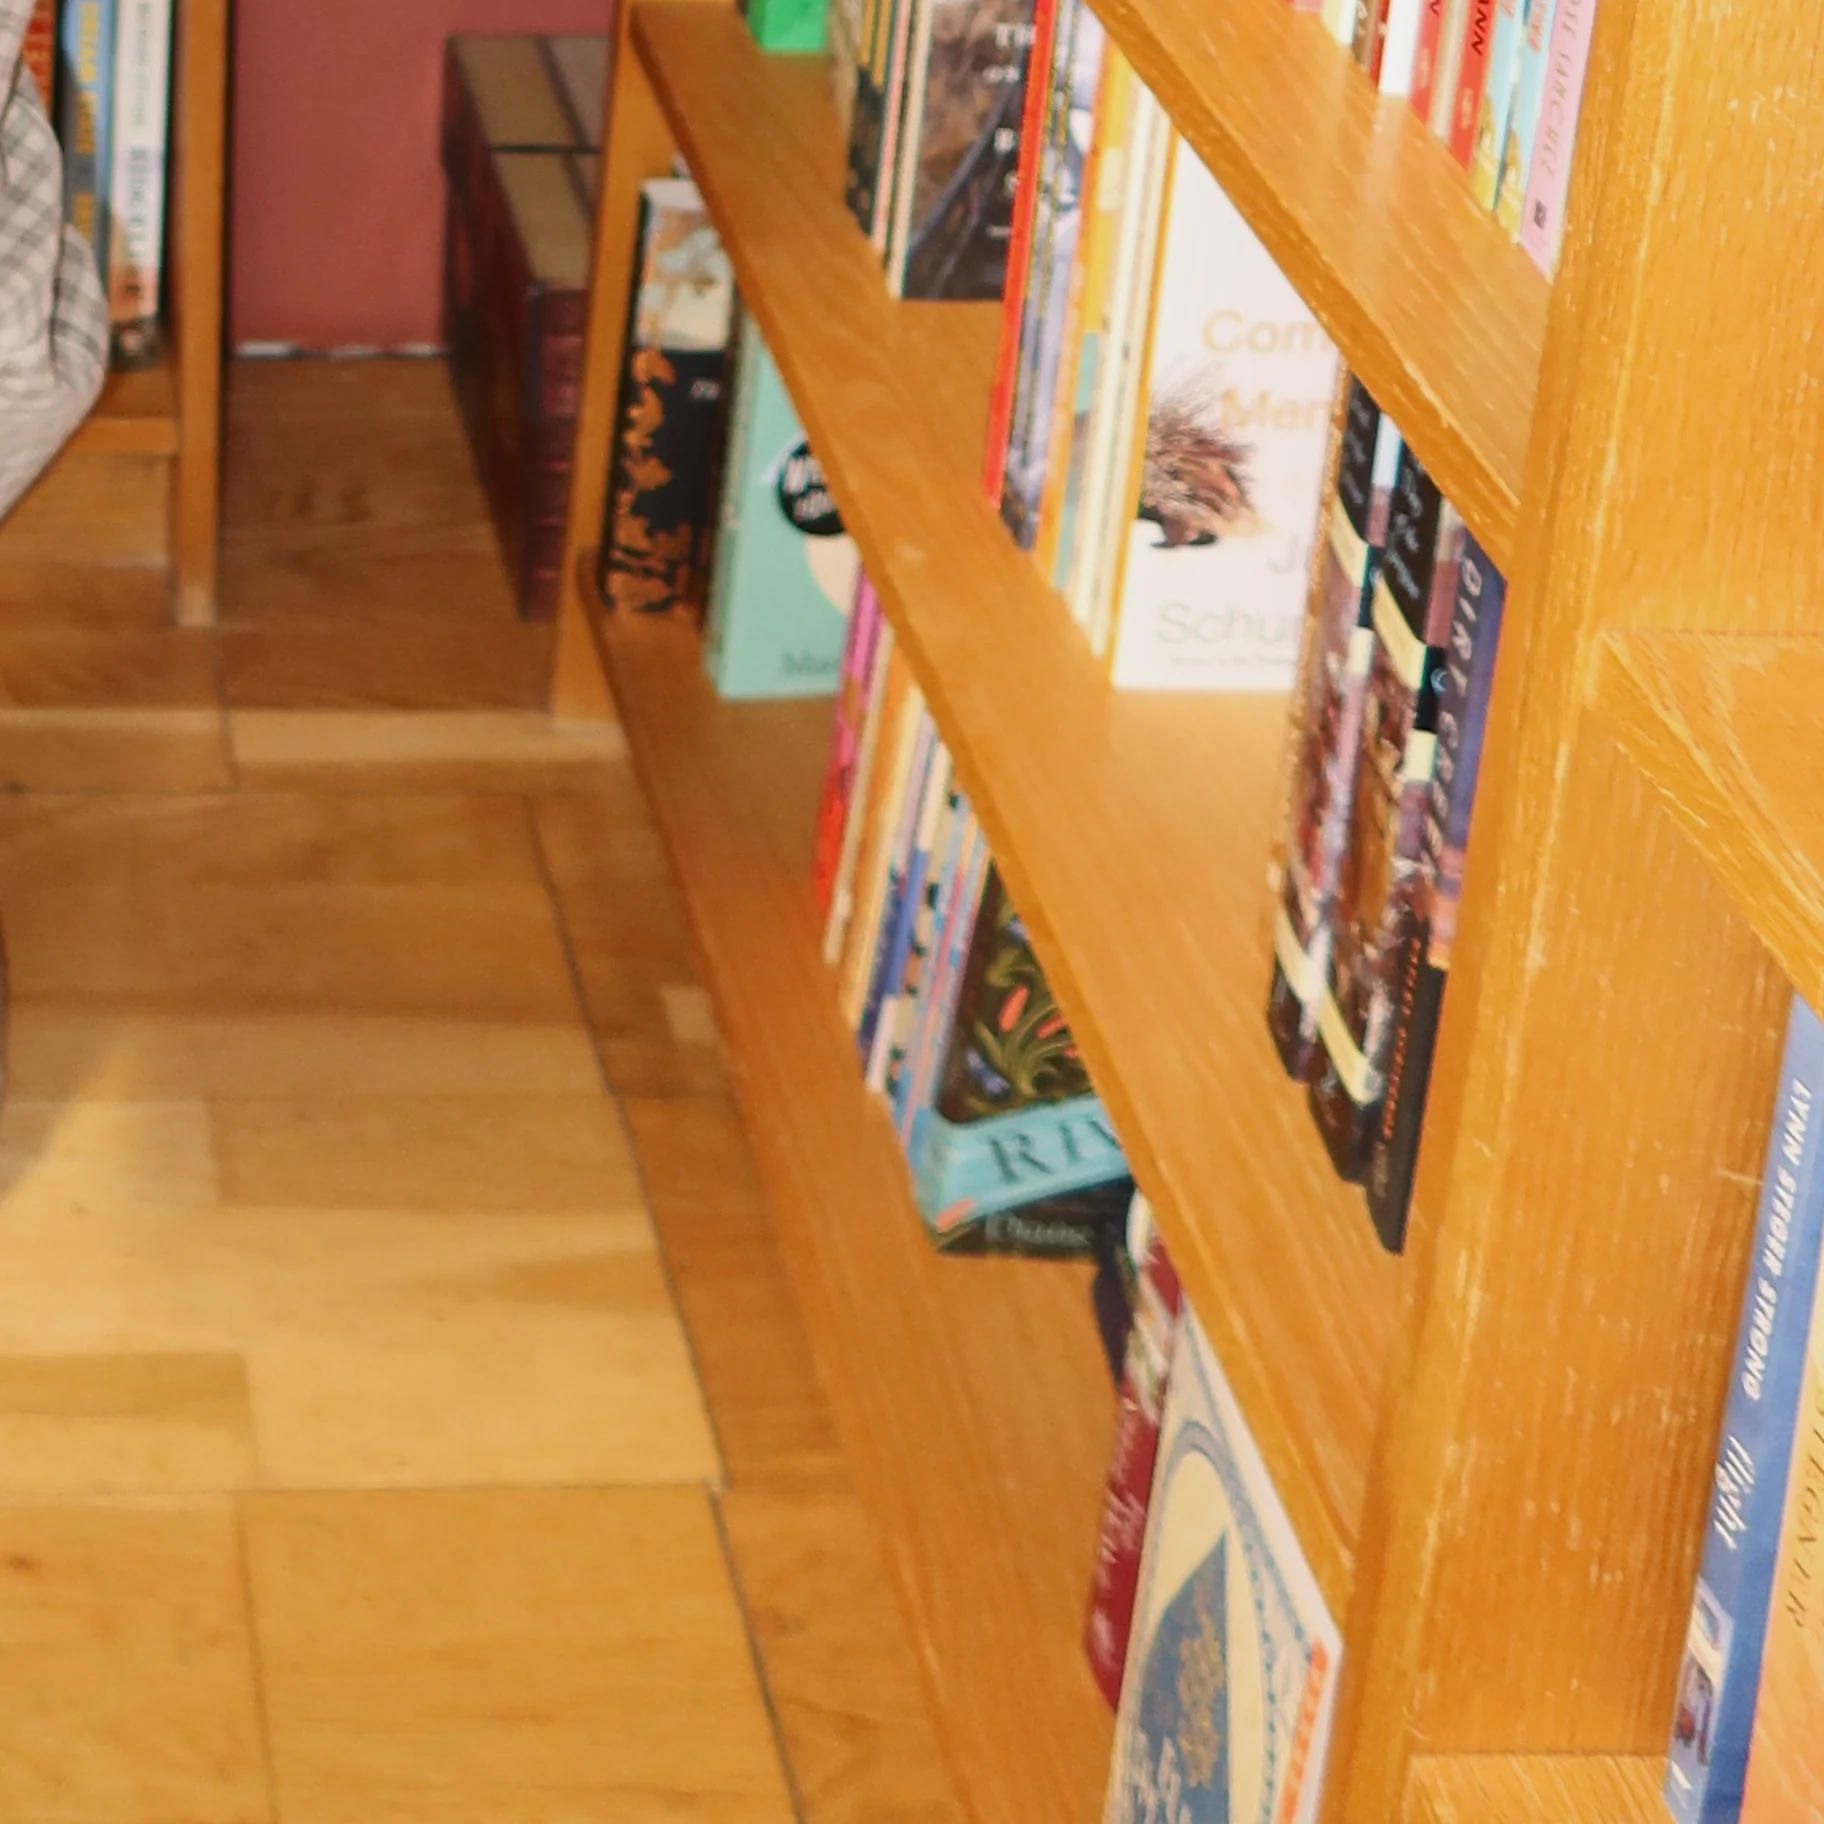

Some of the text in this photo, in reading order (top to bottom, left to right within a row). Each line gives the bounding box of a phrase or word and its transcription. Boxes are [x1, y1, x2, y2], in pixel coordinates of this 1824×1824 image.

[1451, 555, 1484, 698] DIRT
[1742, 1076, 1815, 1402] LYNN STRONG
[1712, 1434, 1759, 1553] Flight
